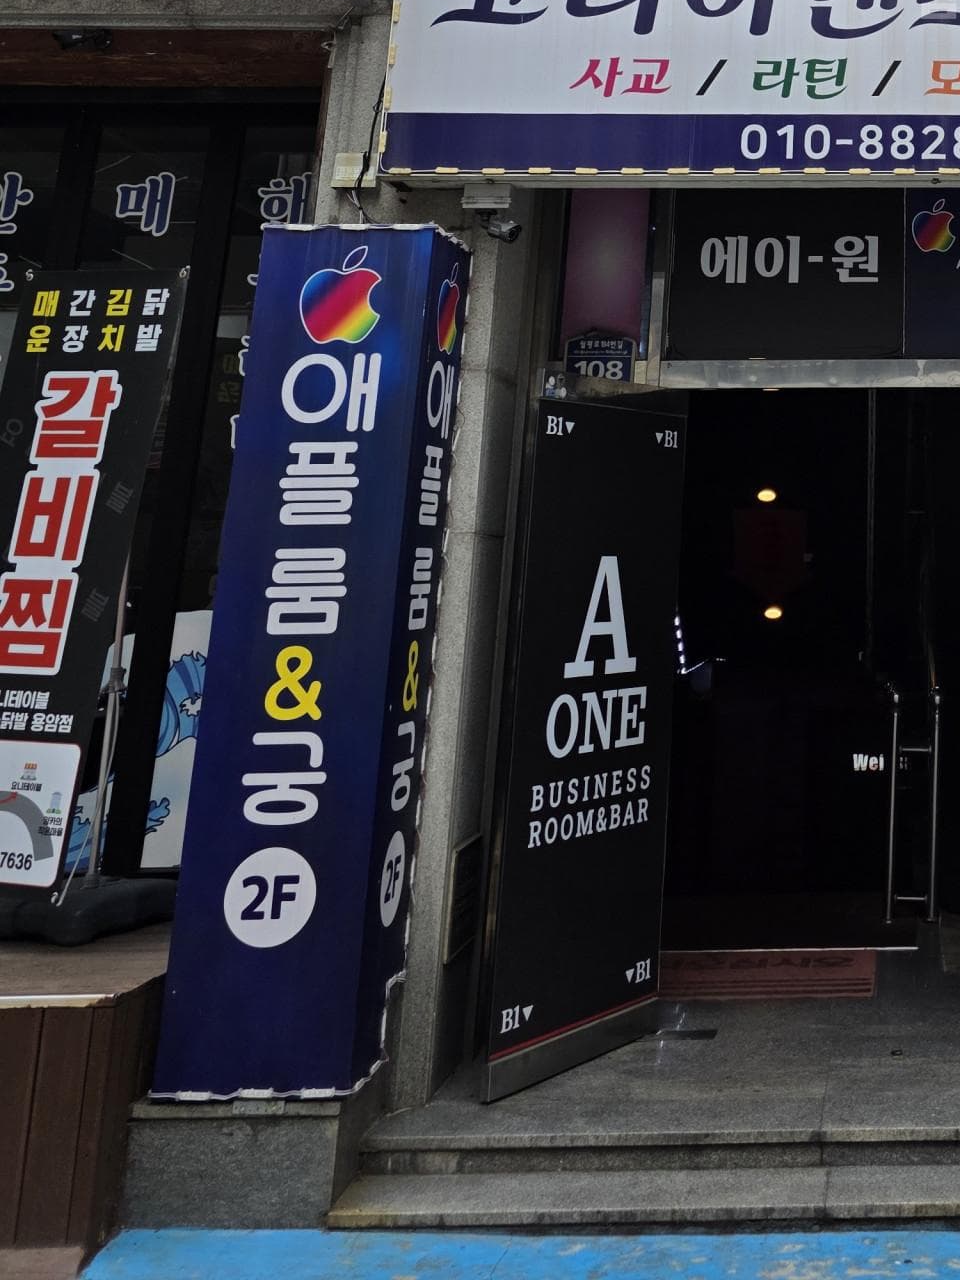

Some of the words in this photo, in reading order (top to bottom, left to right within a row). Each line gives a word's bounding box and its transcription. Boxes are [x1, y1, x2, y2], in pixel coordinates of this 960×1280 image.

[570, 56, 672, 98] 사교
[753, 57, 848, 100] 라틴
[700, 235, 879, 284] 에이-원
[574, 360, 624, 380] 108
[546, 415, 563, 435] B1
[664, 430, 678, 449] B1
[0, 371, 122, 675] 갈비찜
[563, 555, 637, 679] A
[31, 713, 73, 733] 용암점
[546, 686, 648, 759] ONE
[530, 764, 651, 812] BUSINESS
[527, 797, 649, 849] ROOM&BAR
[240, 874, 301, 921] 2F
[383, 853, 402, 904] 2F
[635, 958, 651, 984] B1
[500, 1004, 520, 1034] B1
